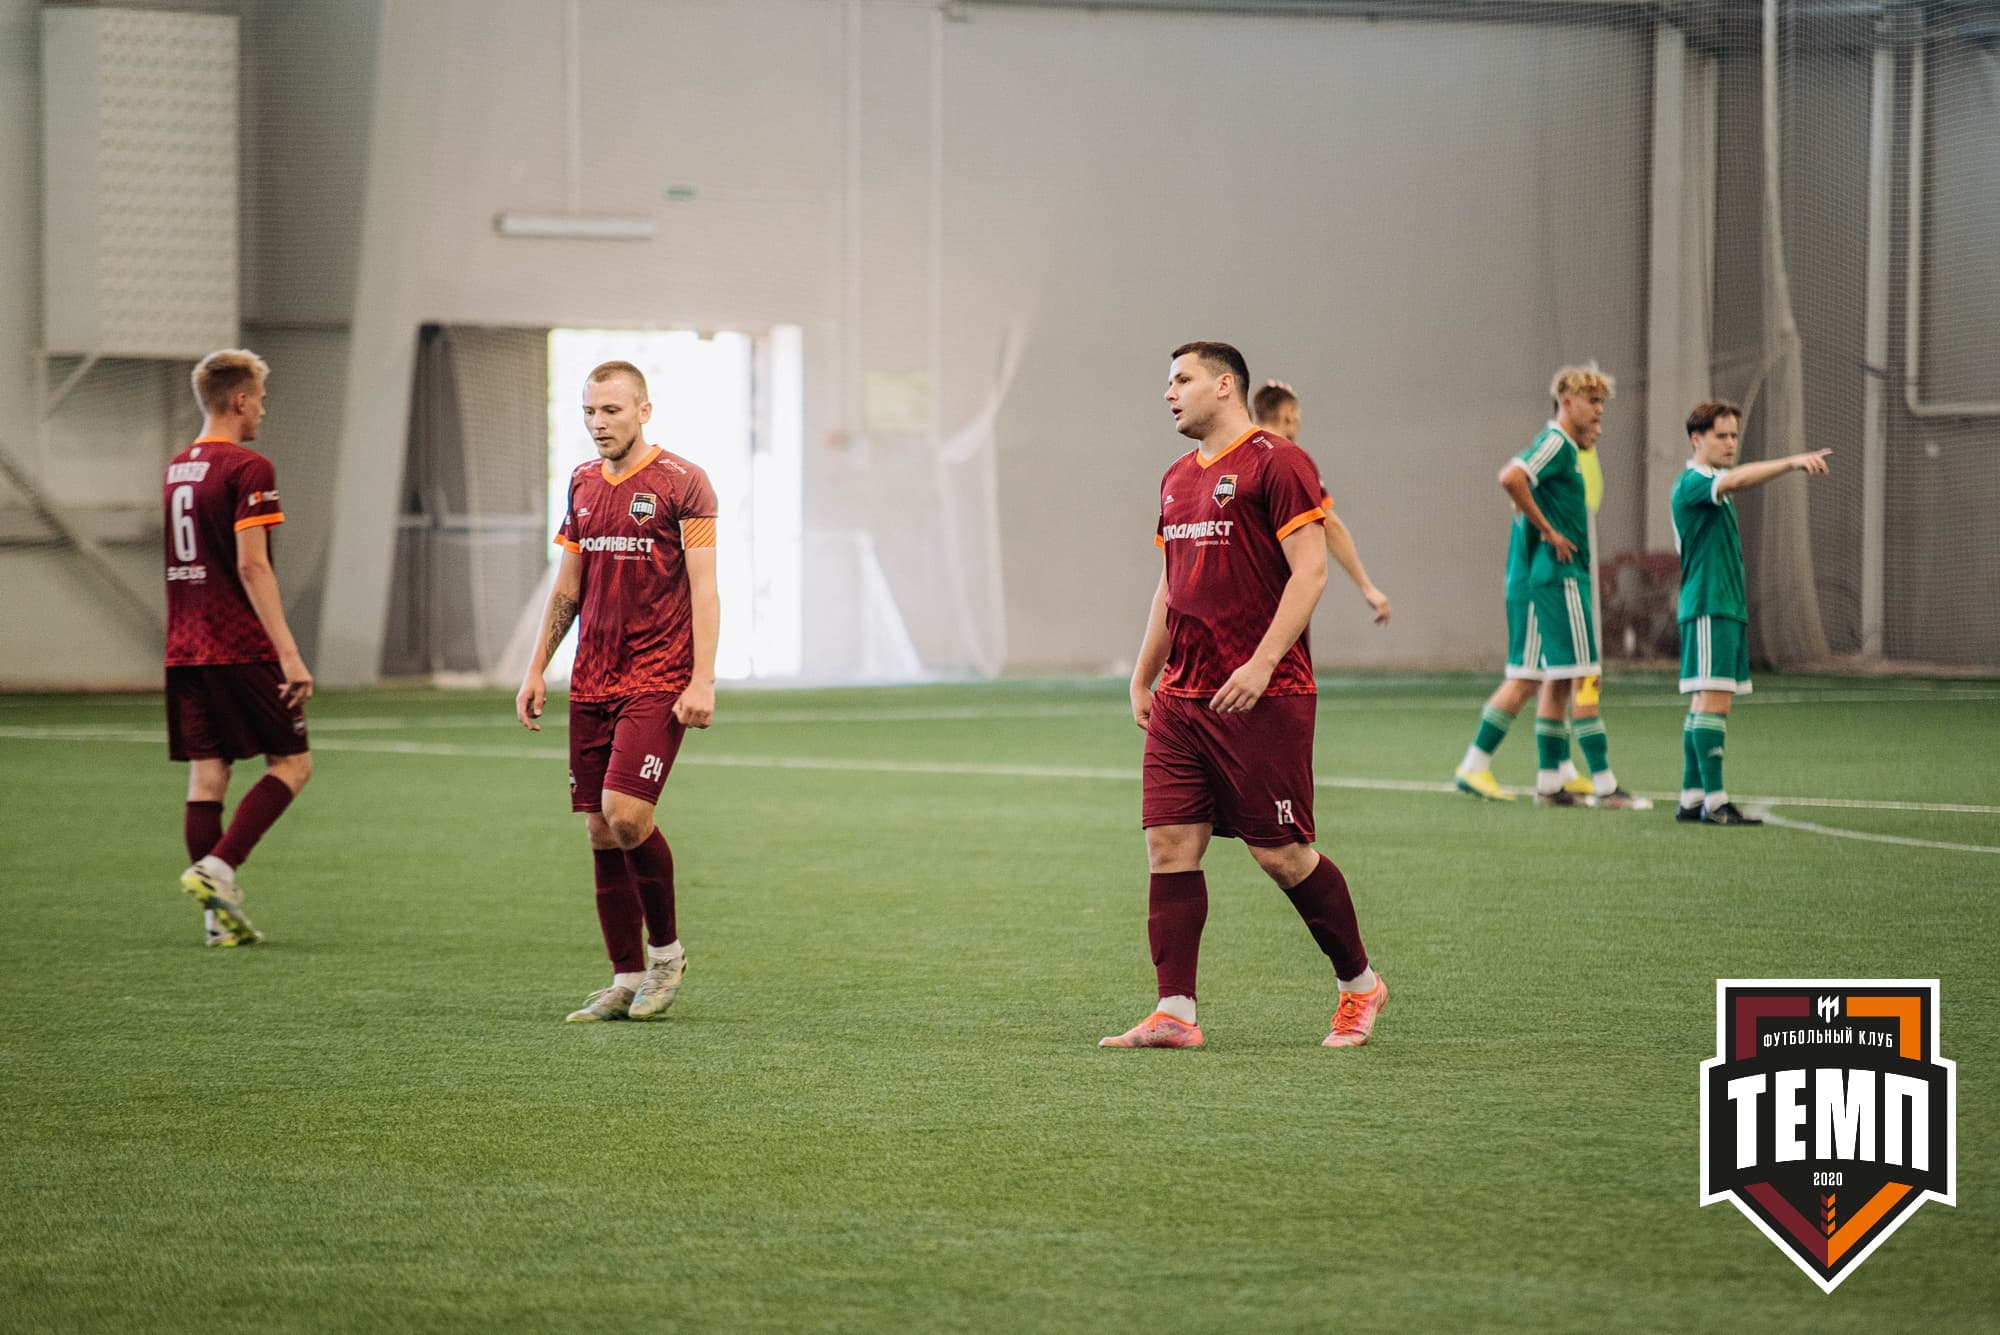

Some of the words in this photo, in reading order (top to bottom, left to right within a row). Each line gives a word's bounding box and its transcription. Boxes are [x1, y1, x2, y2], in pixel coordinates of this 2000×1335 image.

[172, 484, 197, 562] 6
[639, 754, 664, 782] 24
[1275, 799, 1295, 825] 13
